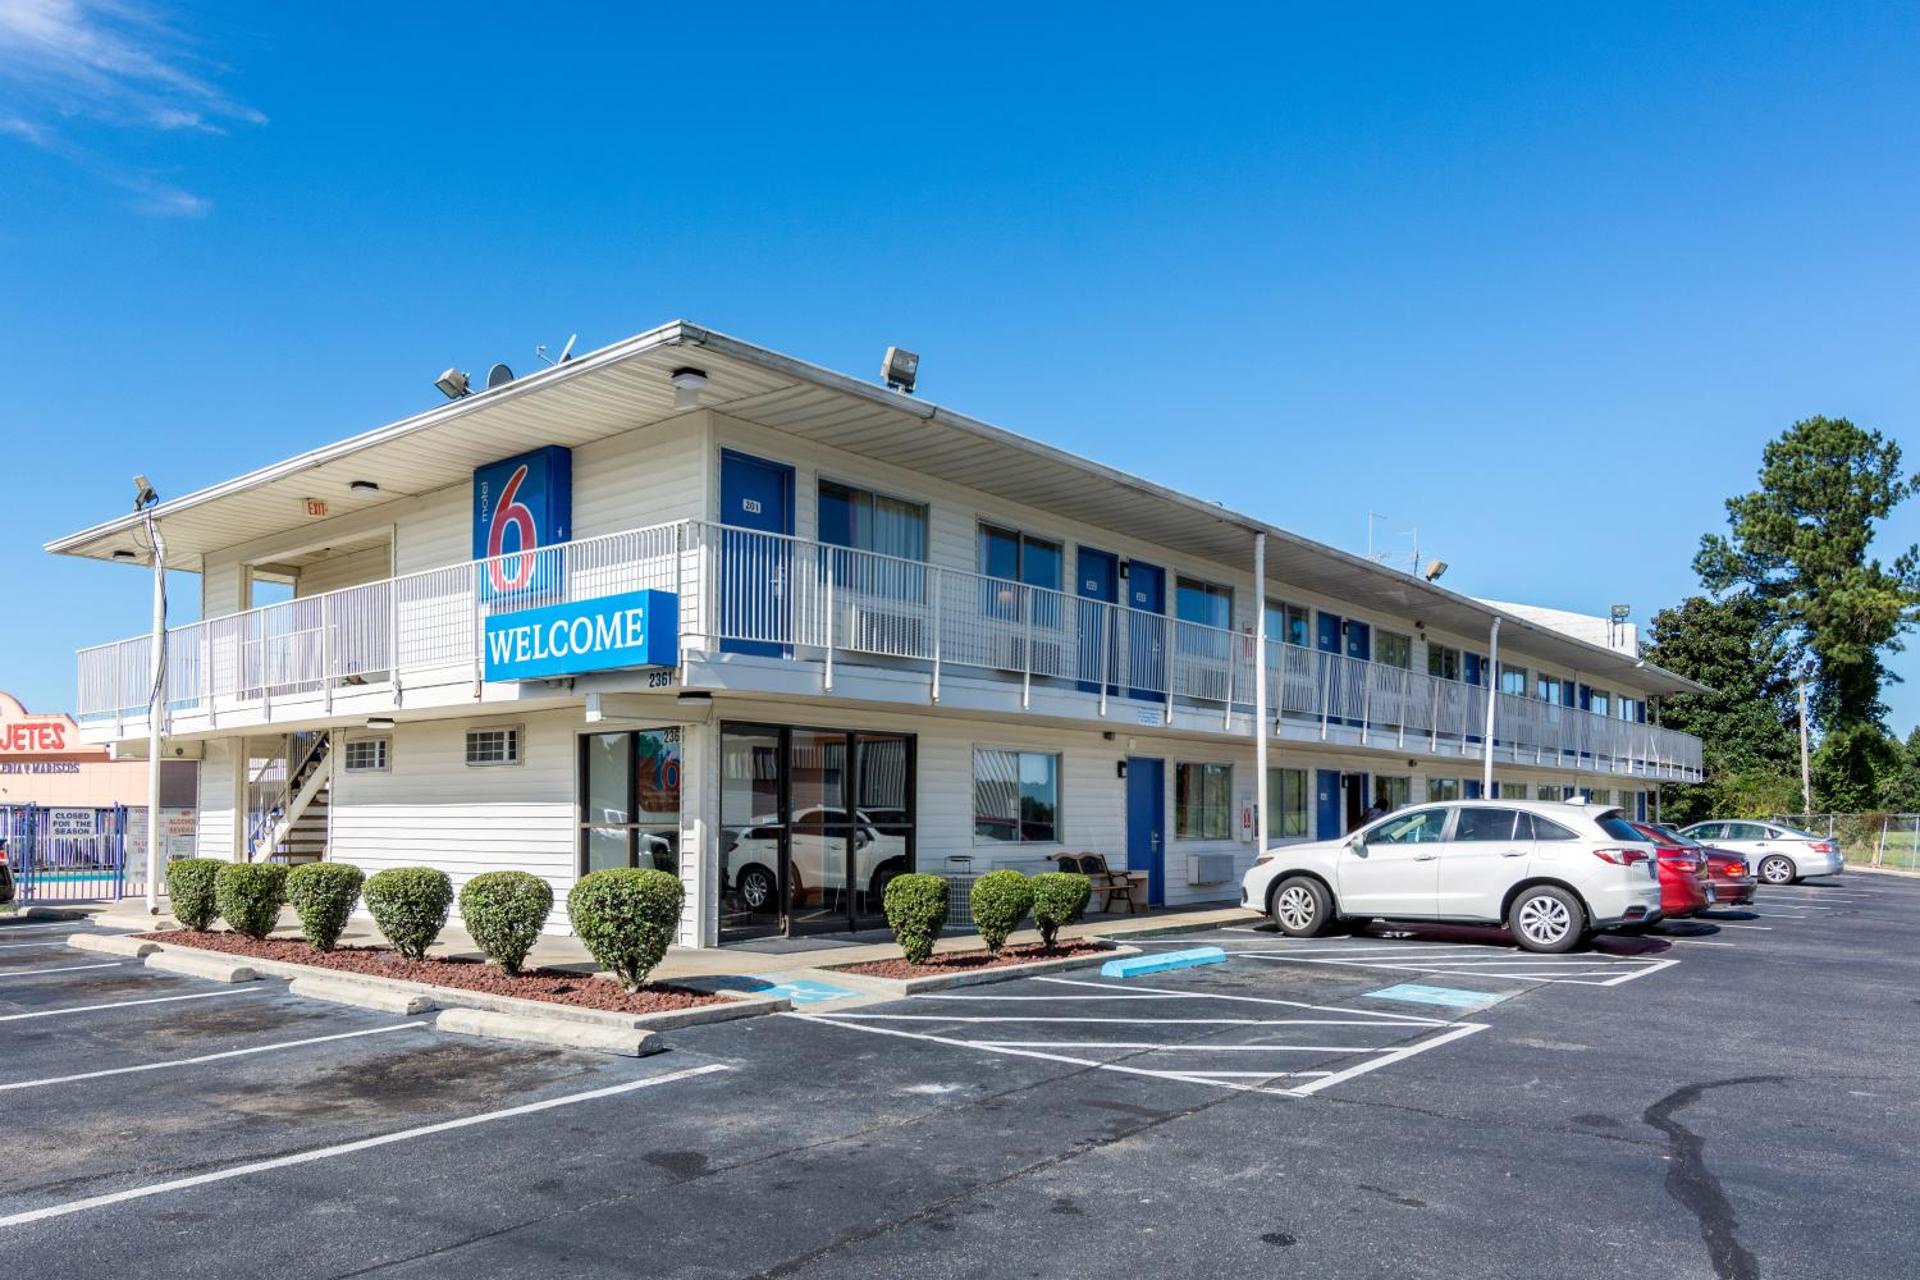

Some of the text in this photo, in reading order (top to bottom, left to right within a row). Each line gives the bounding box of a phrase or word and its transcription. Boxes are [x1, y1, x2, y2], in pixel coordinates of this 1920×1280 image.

[481, 464, 537, 592] motel 6
[488, 608, 644, 665] WELCOME
[649, 672, 672, 687] 2361
[55, 812, 90, 820] CLOSED
[53, 820, 92, 828] FOR THE
